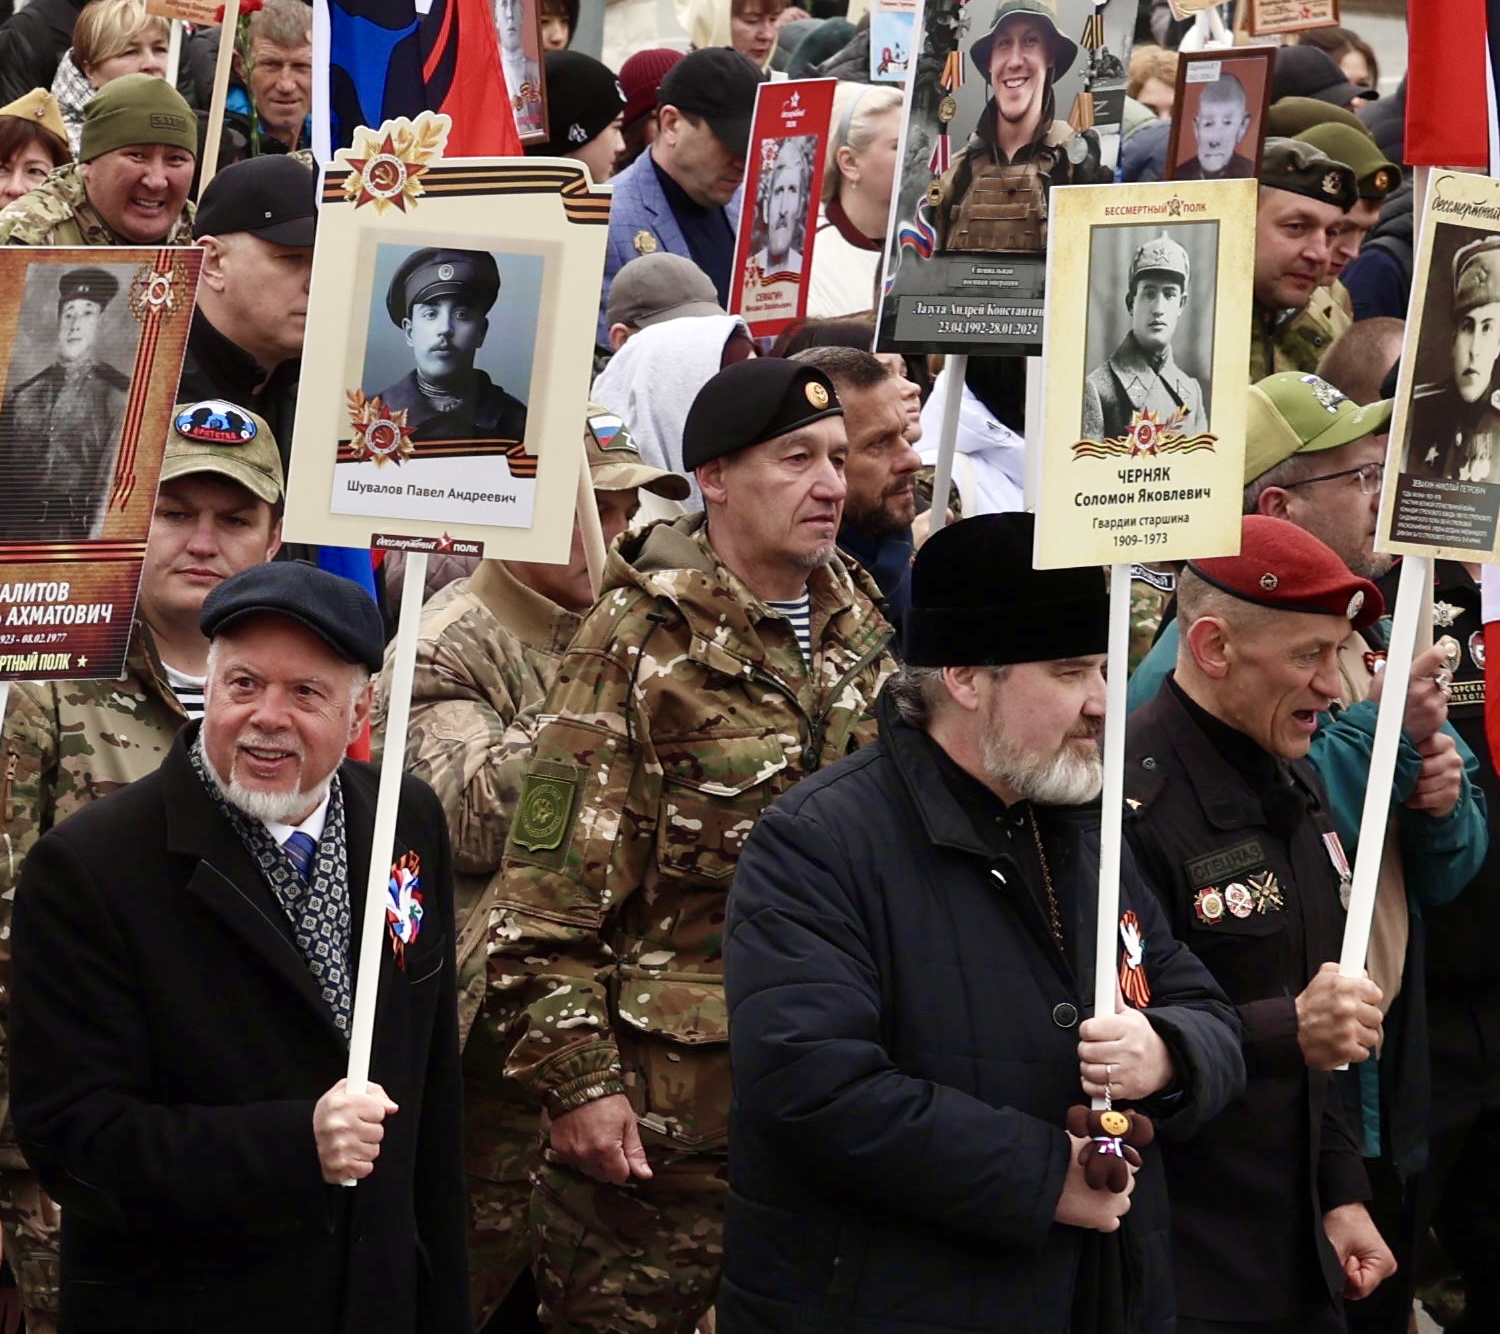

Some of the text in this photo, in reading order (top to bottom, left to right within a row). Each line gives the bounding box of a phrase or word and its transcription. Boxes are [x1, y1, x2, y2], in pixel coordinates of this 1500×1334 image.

[1105, 203, 1206, 216] БЕССМЕРТНЫЙ ПОЛК
[949, 303, 984, 317] Андрей
[987, 304, 1044, 317] Константин
[1117, 466, 1171, 484] ЧЕРНЯК
[346, 479, 517, 504] Шувалов Павел Андреевич
[1074, 487, 1211, 508] Соломон Яковлевич
[1092, 513, 1190, 531] Гвардии старшина
[452, 543, 479, 553] ПОЛК
[5, 604, 113, 626] АХМАТОВИЧ
[39, 653, 72, 671] ПОЛК
